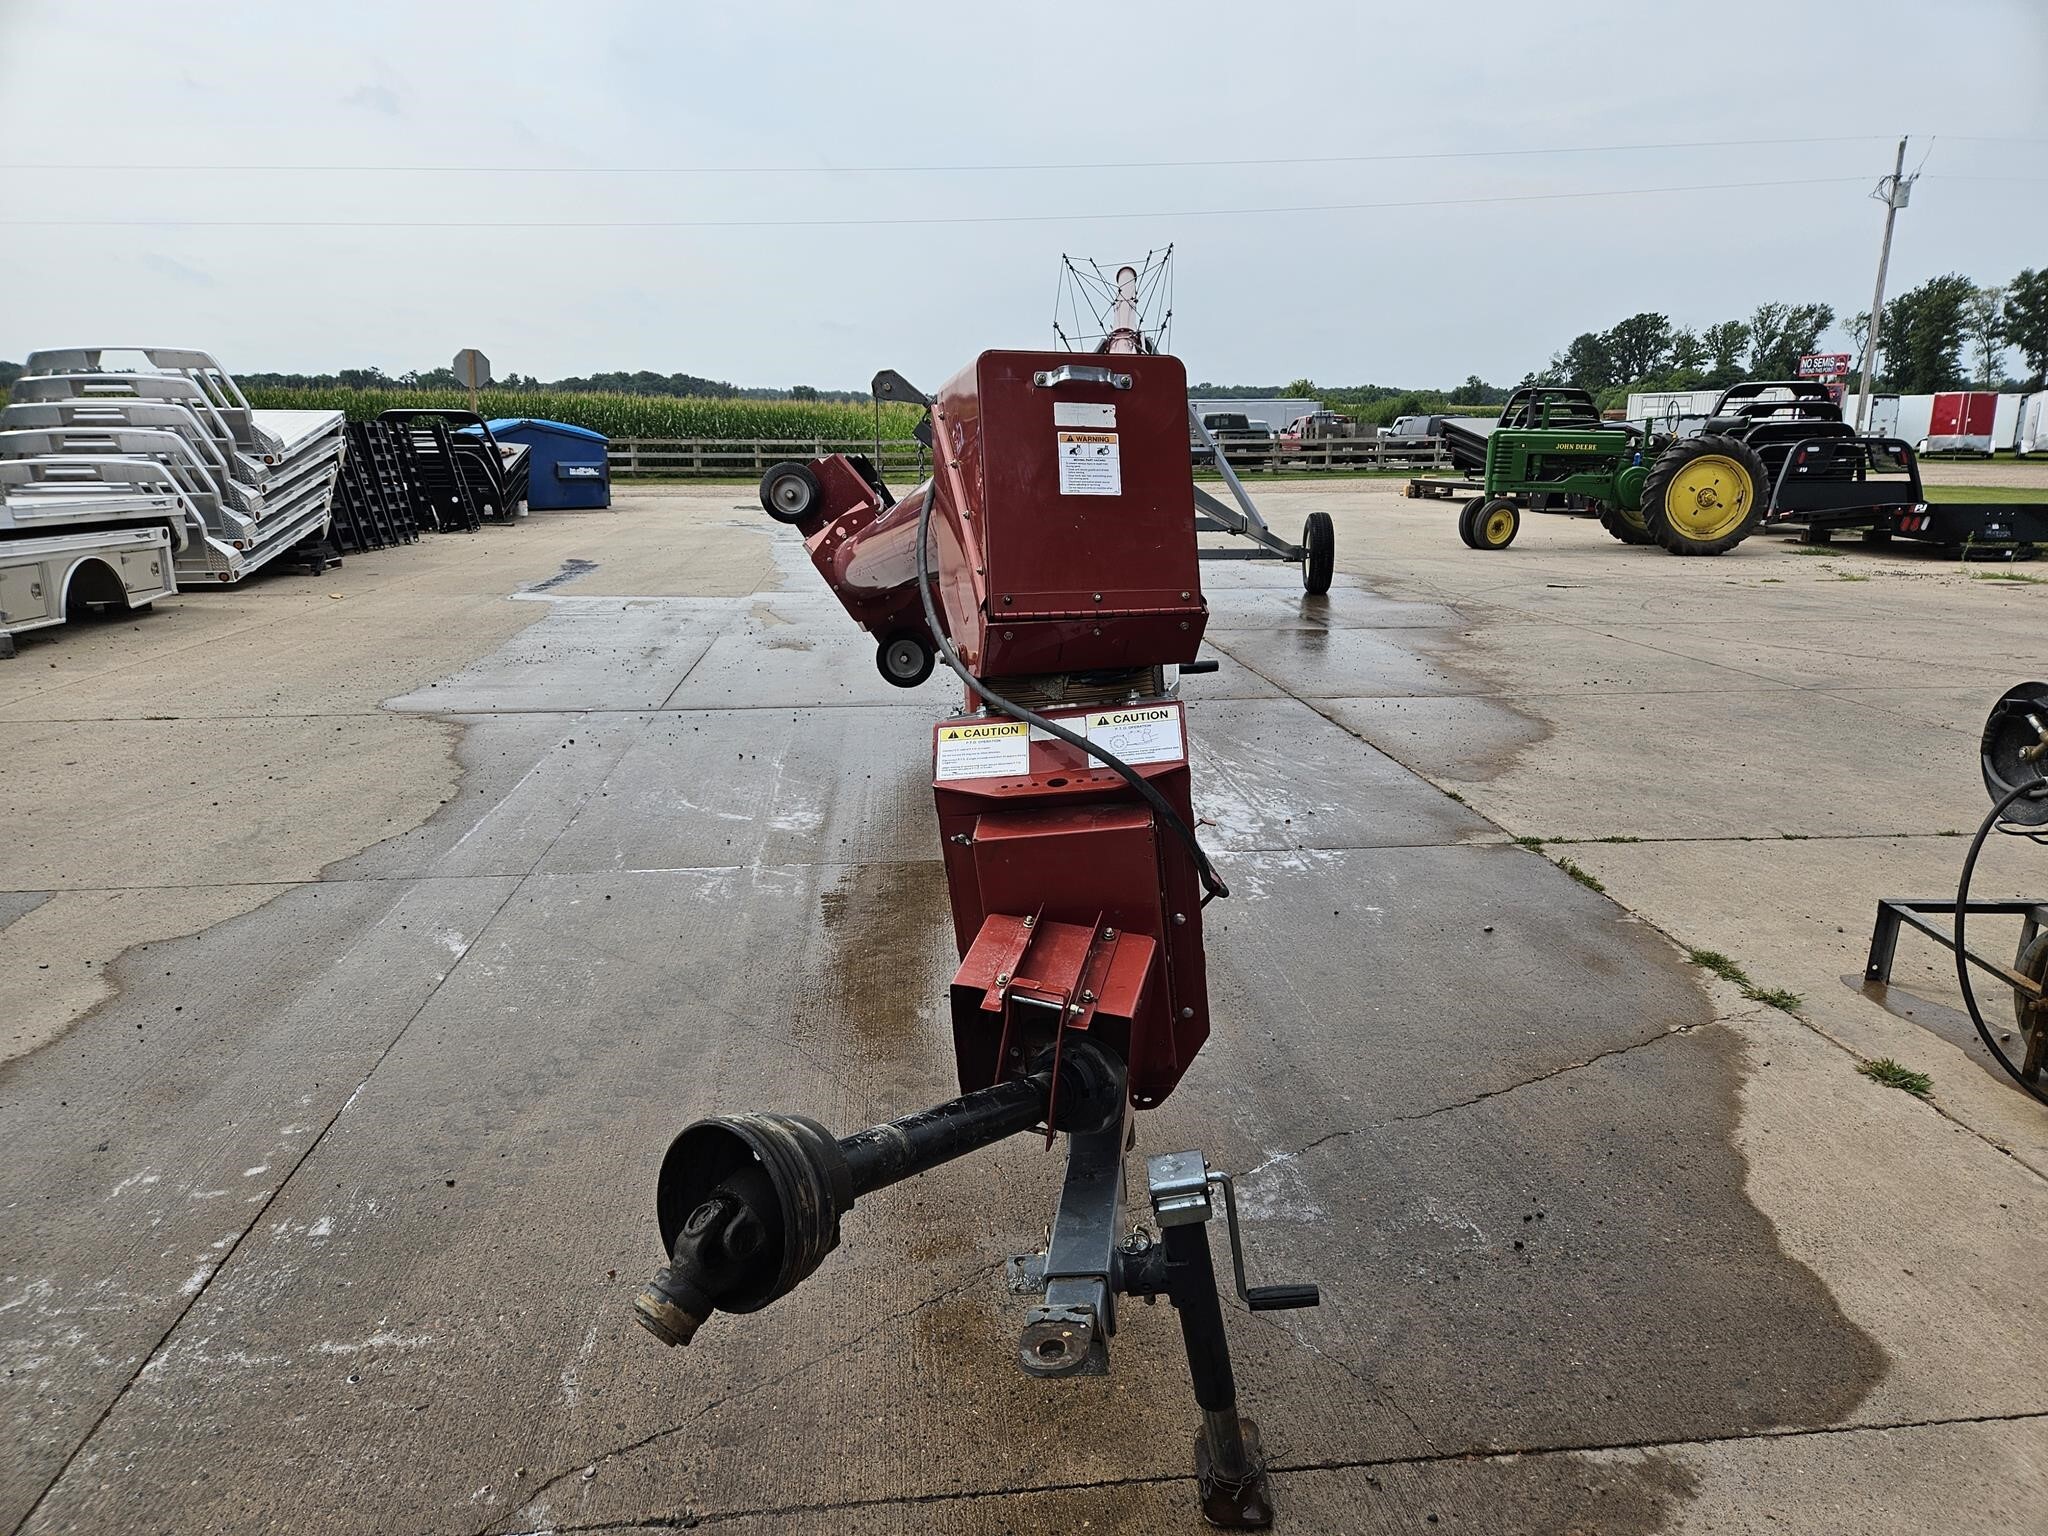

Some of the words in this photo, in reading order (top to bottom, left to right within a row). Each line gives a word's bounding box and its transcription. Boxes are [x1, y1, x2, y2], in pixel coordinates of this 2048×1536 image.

[1801, 358, 1812, 368] NO
[1813, 357, 1835, 367] SEMIS
[1914, 504, 1927, 513] PJ
[1113, 710, 1169, 724] CAUTION
[963, 726, 1019, 738] CAUTION
